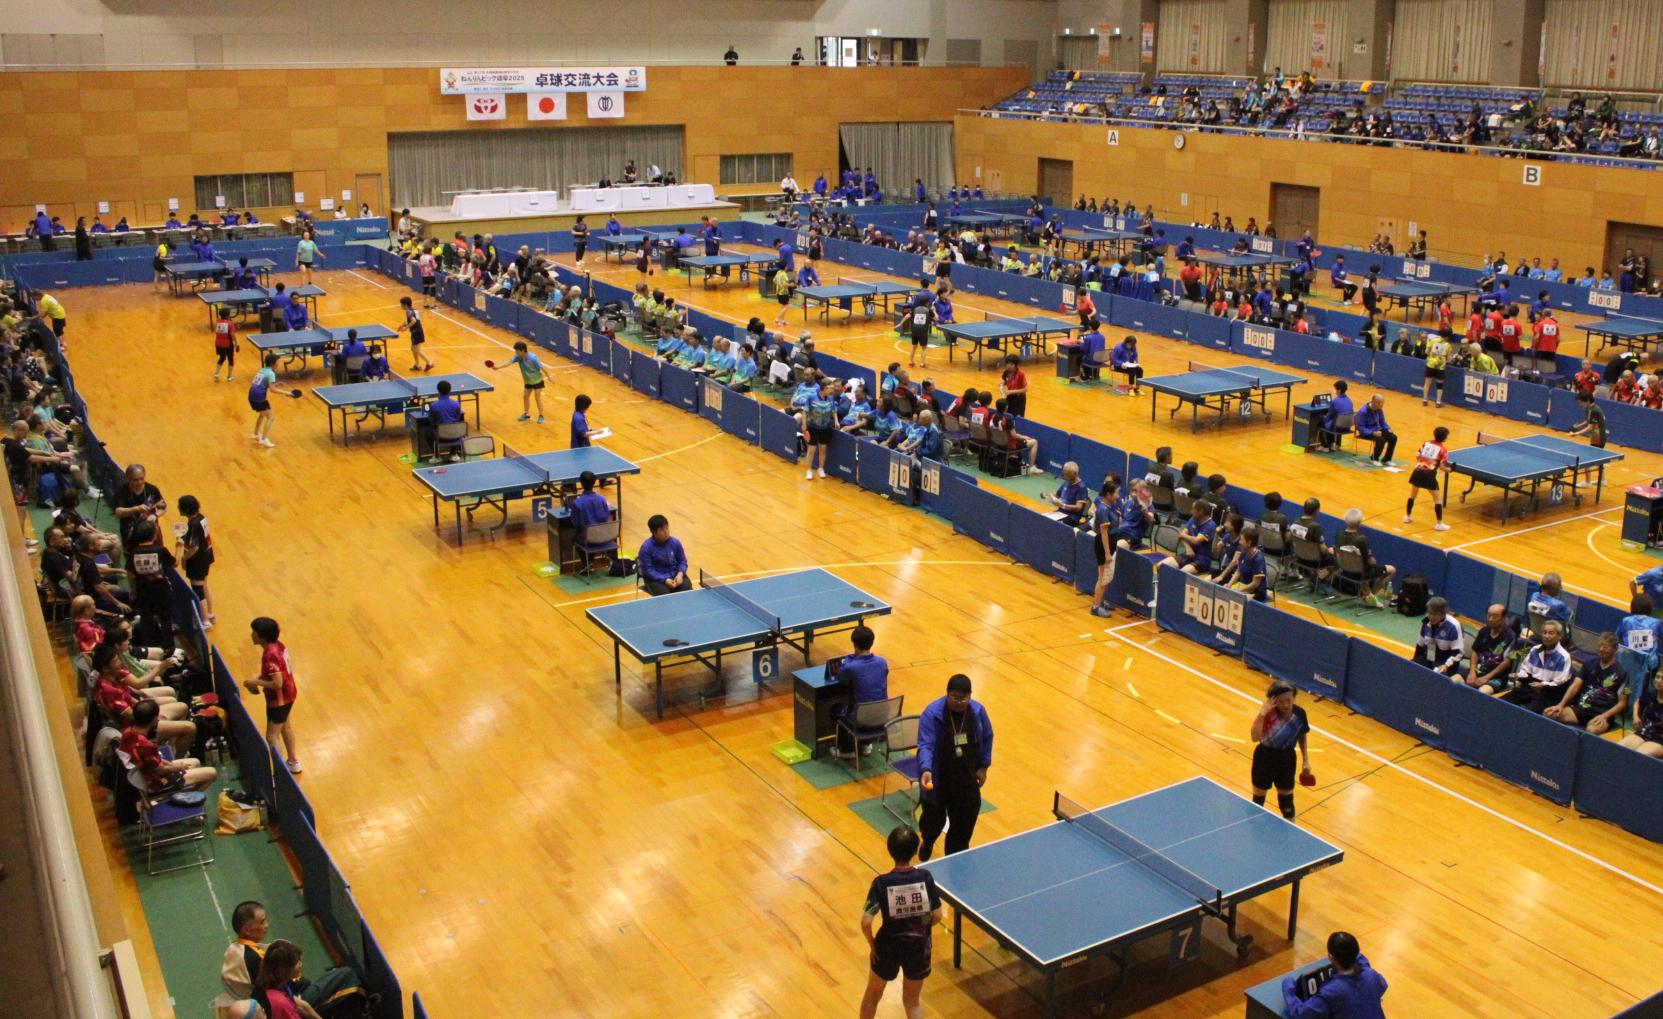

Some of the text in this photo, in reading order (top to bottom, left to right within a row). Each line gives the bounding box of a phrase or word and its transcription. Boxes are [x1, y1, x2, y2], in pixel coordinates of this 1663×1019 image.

[535, 72, 619, 88] 卓球交流大会
[1109, 131, 1117, 144] A
[1526, 167, 1538, 183] B
[1240, 401, 1252, 416] 12
[1551, 484, 1563, 501] 13
[537, 500, 548, 519] 5
[1201, 602, 1225, 624] 0 0
[759, 653, 772, 678] 6
[895, 892, 922, 906] 池田
[1178, 927, 1193, 959] 7
[1307, 977, 1318, 996] 0
